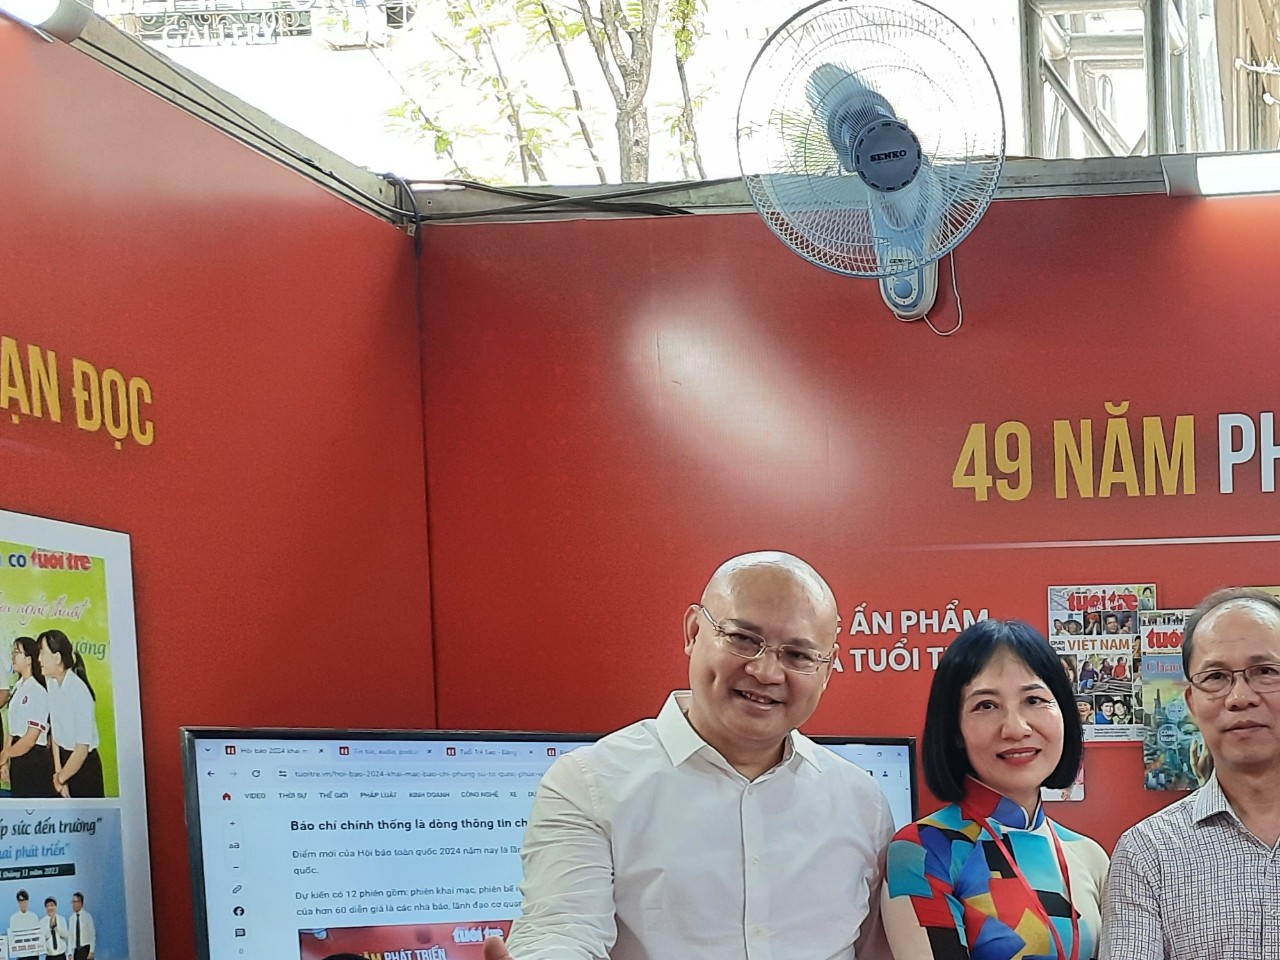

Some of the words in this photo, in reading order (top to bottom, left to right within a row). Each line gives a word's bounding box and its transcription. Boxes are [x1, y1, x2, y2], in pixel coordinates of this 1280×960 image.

[870, 149, 907, 161] SENKO
[72, 356, 155, 450] ĐỌC
[952, 420, 1033, 502] 49
[1053, 400, 1197, 499] NĂM
[850, 601, 894, 636] ẤN
[899, 598, 990, 634] PHẨM
[1067, 636, 1098, 653] VIỆT
[1100, 638, 1130, 651] NAM
[849, 637, 921, 673] TUỔI
[11, 819, 31, 836] sức
[34, 816, 56, 835] đến
[290, 820, 315, 831] Báo
[319, 820, 337, 831] chí
[340, 819, 374, 831] chính
[377, 818, 412, 832] thống
[415, 818, 425, 829] là
[429, 818, 458, 831] dòng
[461, 818, 494, 830] thông
[497, 817, 512, 828] tin
[375, 848, 392, 857] báo
[439, 847, 461, 855] 2024
[332, 890, 344, 899] có
[346, 890, 357, 898] 12
[436, 886, 455, 896] khai
[335, 906, 347, 914] 60
[396, 903, 412, 912] các
